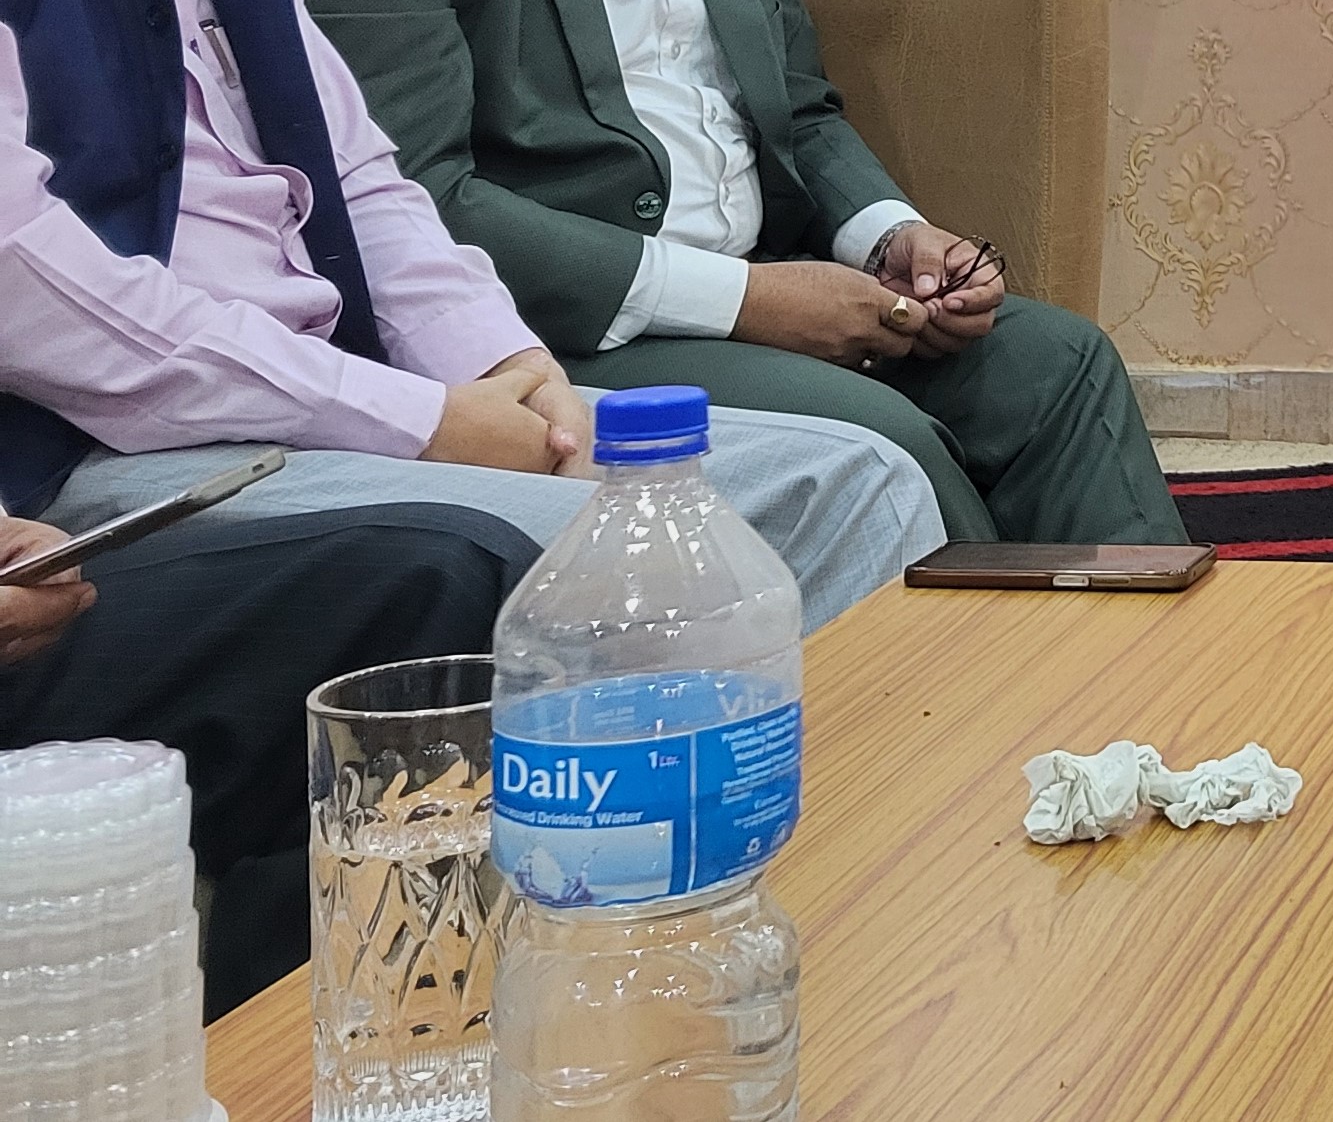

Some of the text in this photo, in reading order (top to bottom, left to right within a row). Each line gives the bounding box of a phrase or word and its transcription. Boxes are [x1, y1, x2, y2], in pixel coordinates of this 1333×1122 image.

[648, 750, 658, 769] 1
[502, 752, 618, 813] Daily
[537, 811, 593, 828] Drinking
[595, 811, 644, 827] Water
